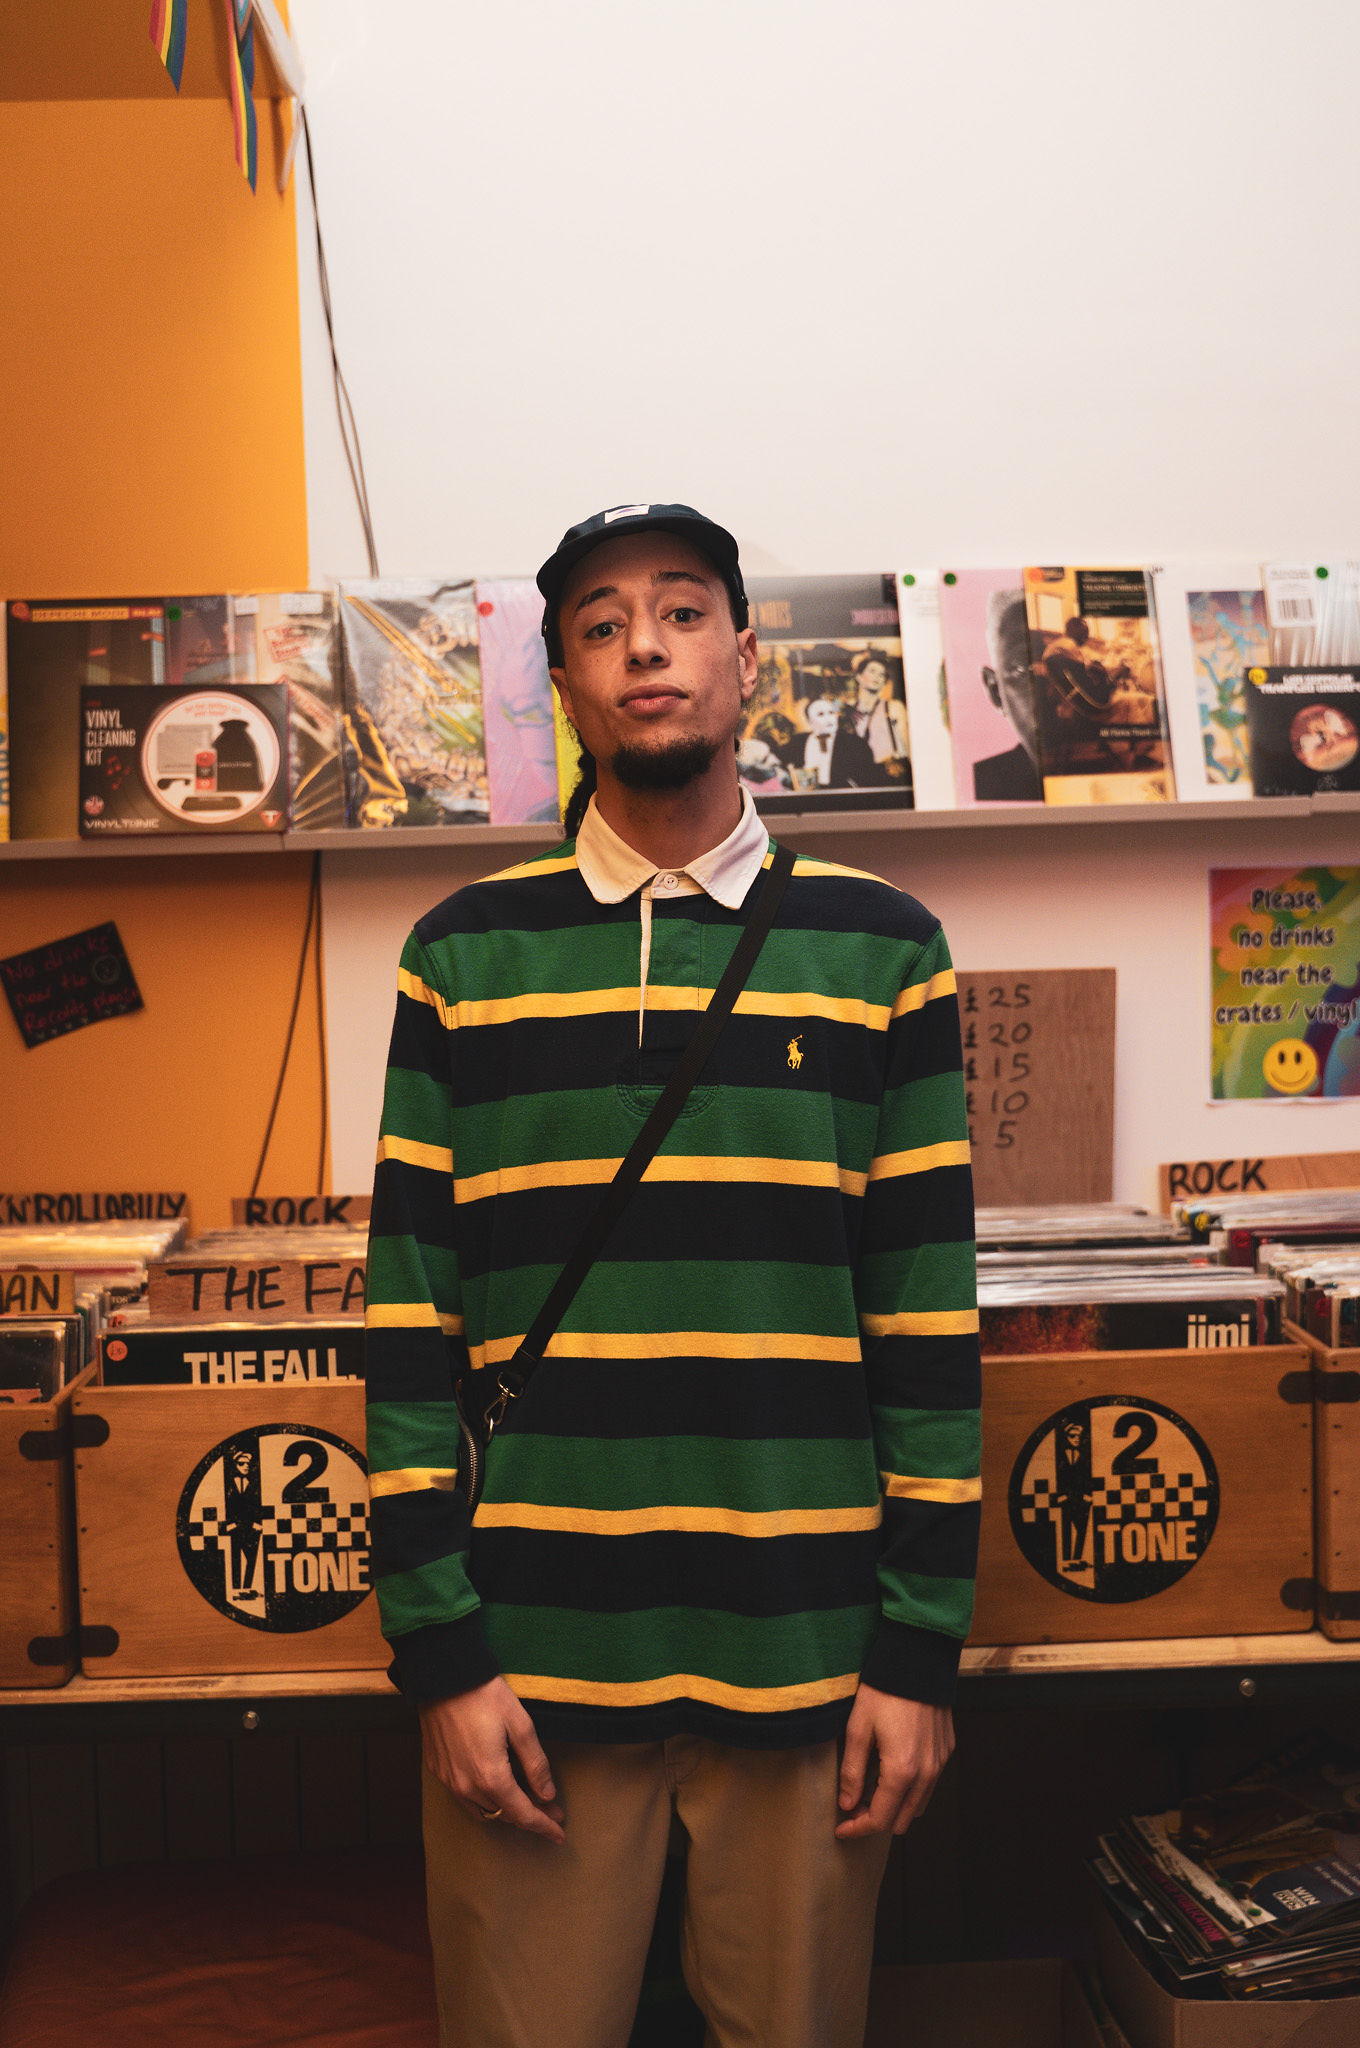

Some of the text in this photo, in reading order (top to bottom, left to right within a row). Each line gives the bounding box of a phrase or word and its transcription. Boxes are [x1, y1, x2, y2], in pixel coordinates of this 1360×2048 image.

[86, 709, 122, 728] VINYL
[86, 730, 136, 747] CLEANING
[85, 748, 103, 766] KIT
[1238, 924, 1335, 947] no drinks
[1241, 963, 1332, 985] near the
[1215, 1002, 1282, 1024] crates
[1304, 996, 1358, 1028] vinyl
[1169, 1159, 1266, 1196] ROCK
[246, 1195, 354, 1226] ROCK
[0, 1274, 60, 1313] AN
[166, 1265, 287, 1312] THE
[184, 1351, 258, 1384] THE
[1111, 1411, 1159, 1475] 2
[281, 1440, 330, 1504] 2
[1097, 1520, 1198, 1564] TONE
[267, 1550, 371, 1593] TONE
